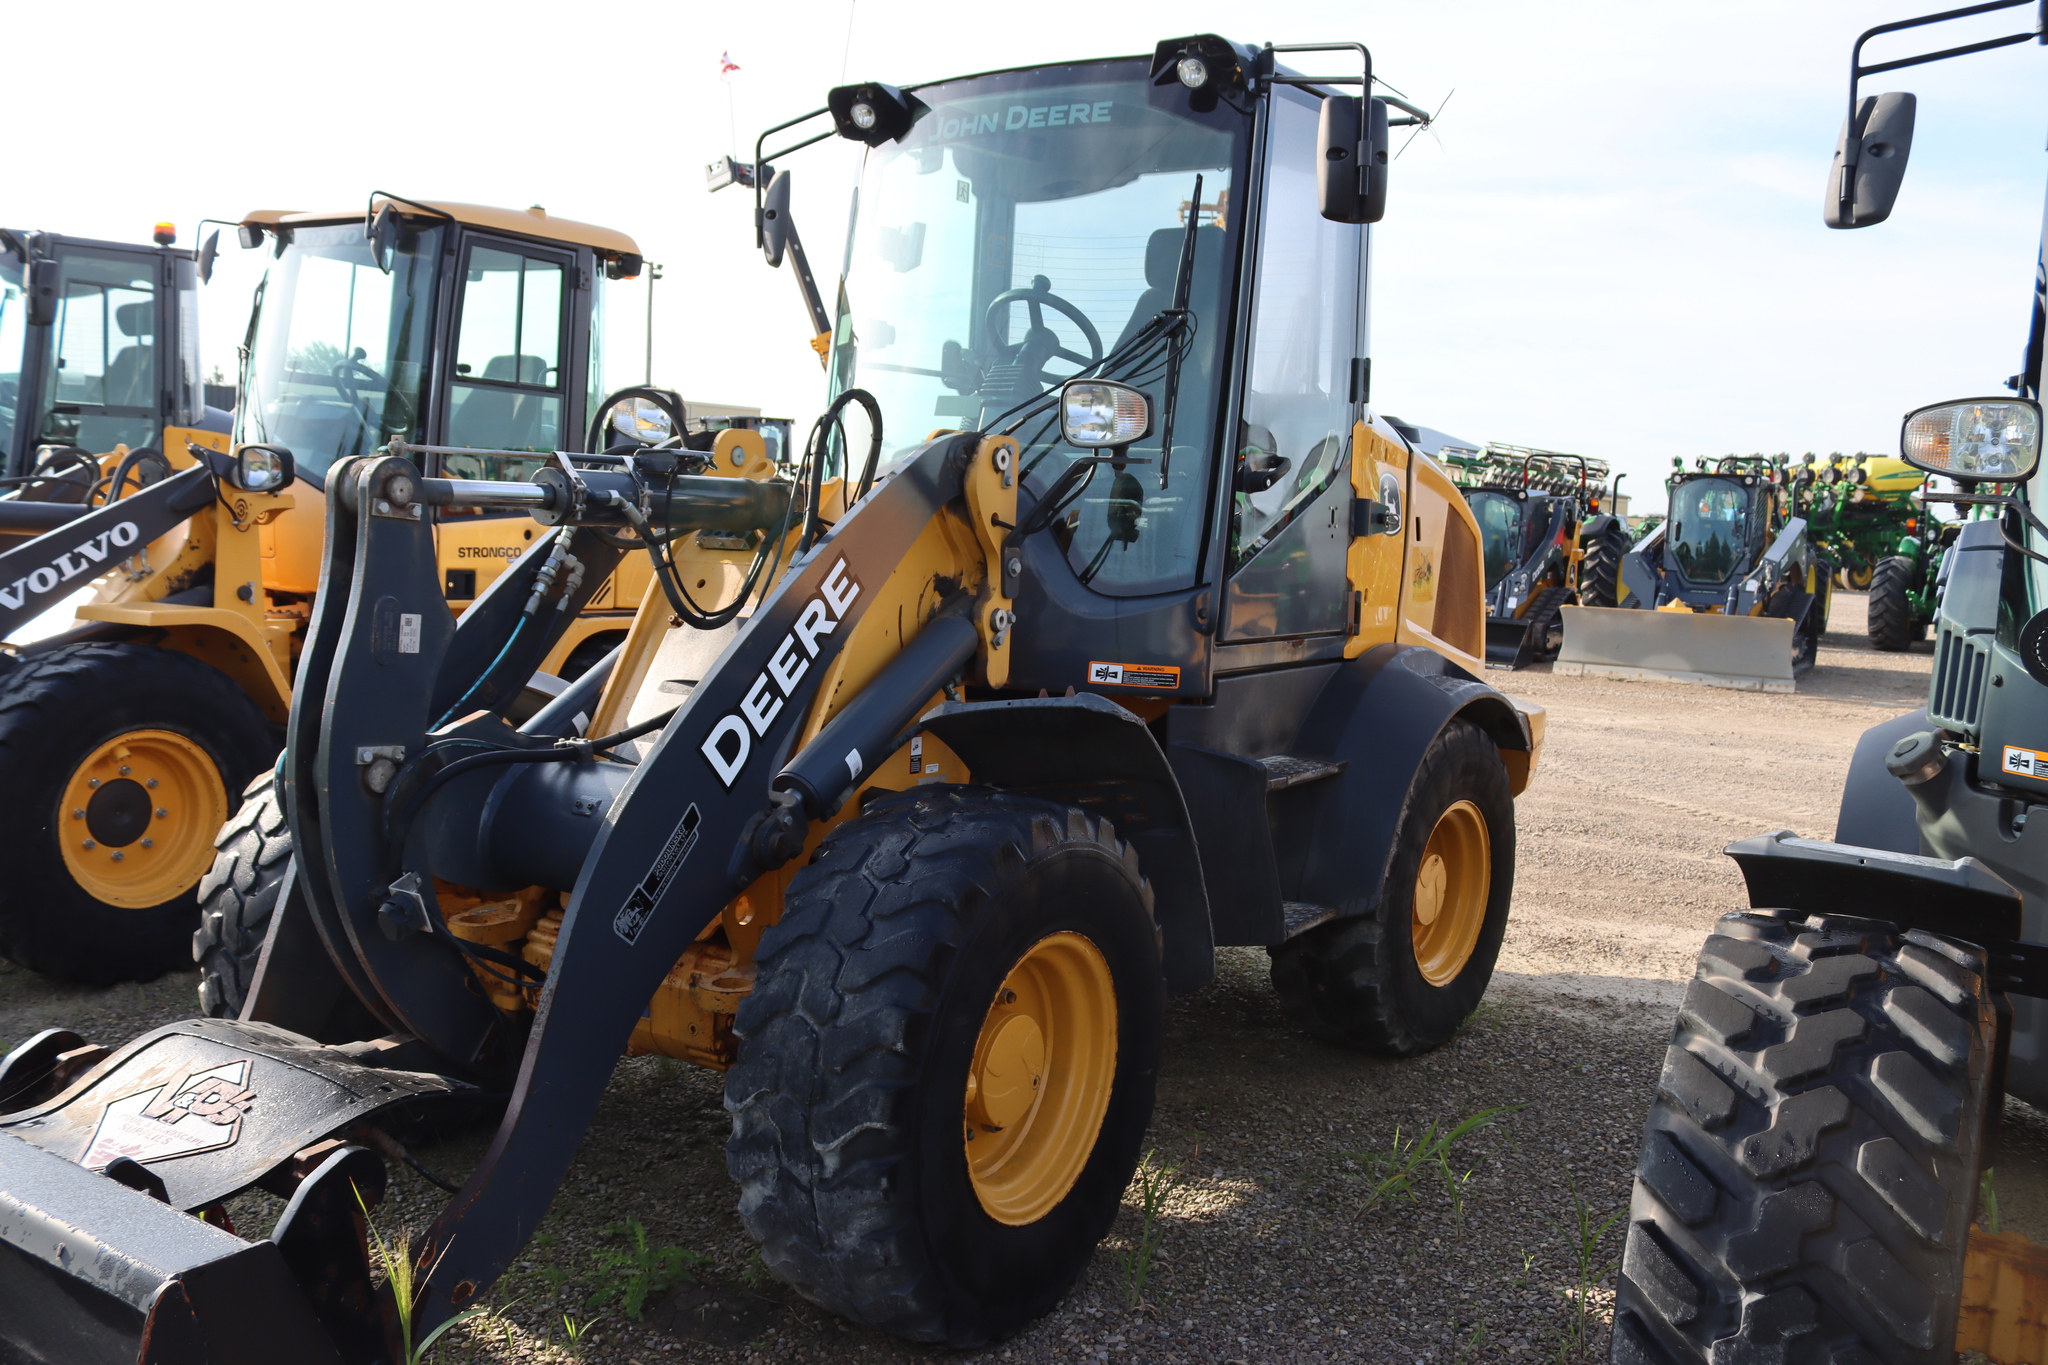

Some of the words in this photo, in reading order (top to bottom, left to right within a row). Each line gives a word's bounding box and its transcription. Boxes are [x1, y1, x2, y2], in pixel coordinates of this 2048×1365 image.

[928, 112, 999, 142] JOHN
[1005, 101, 1114, 131] DEERE
[0, 521, 139, 610] VOLVO
[458, 547, 522, 558] STRONGCO
[701, 557, 860, 788] DEERE
[652, 824, 686, 876] PODOLINSKY
[120, 1123, 173, 1146] SUPPLIES
